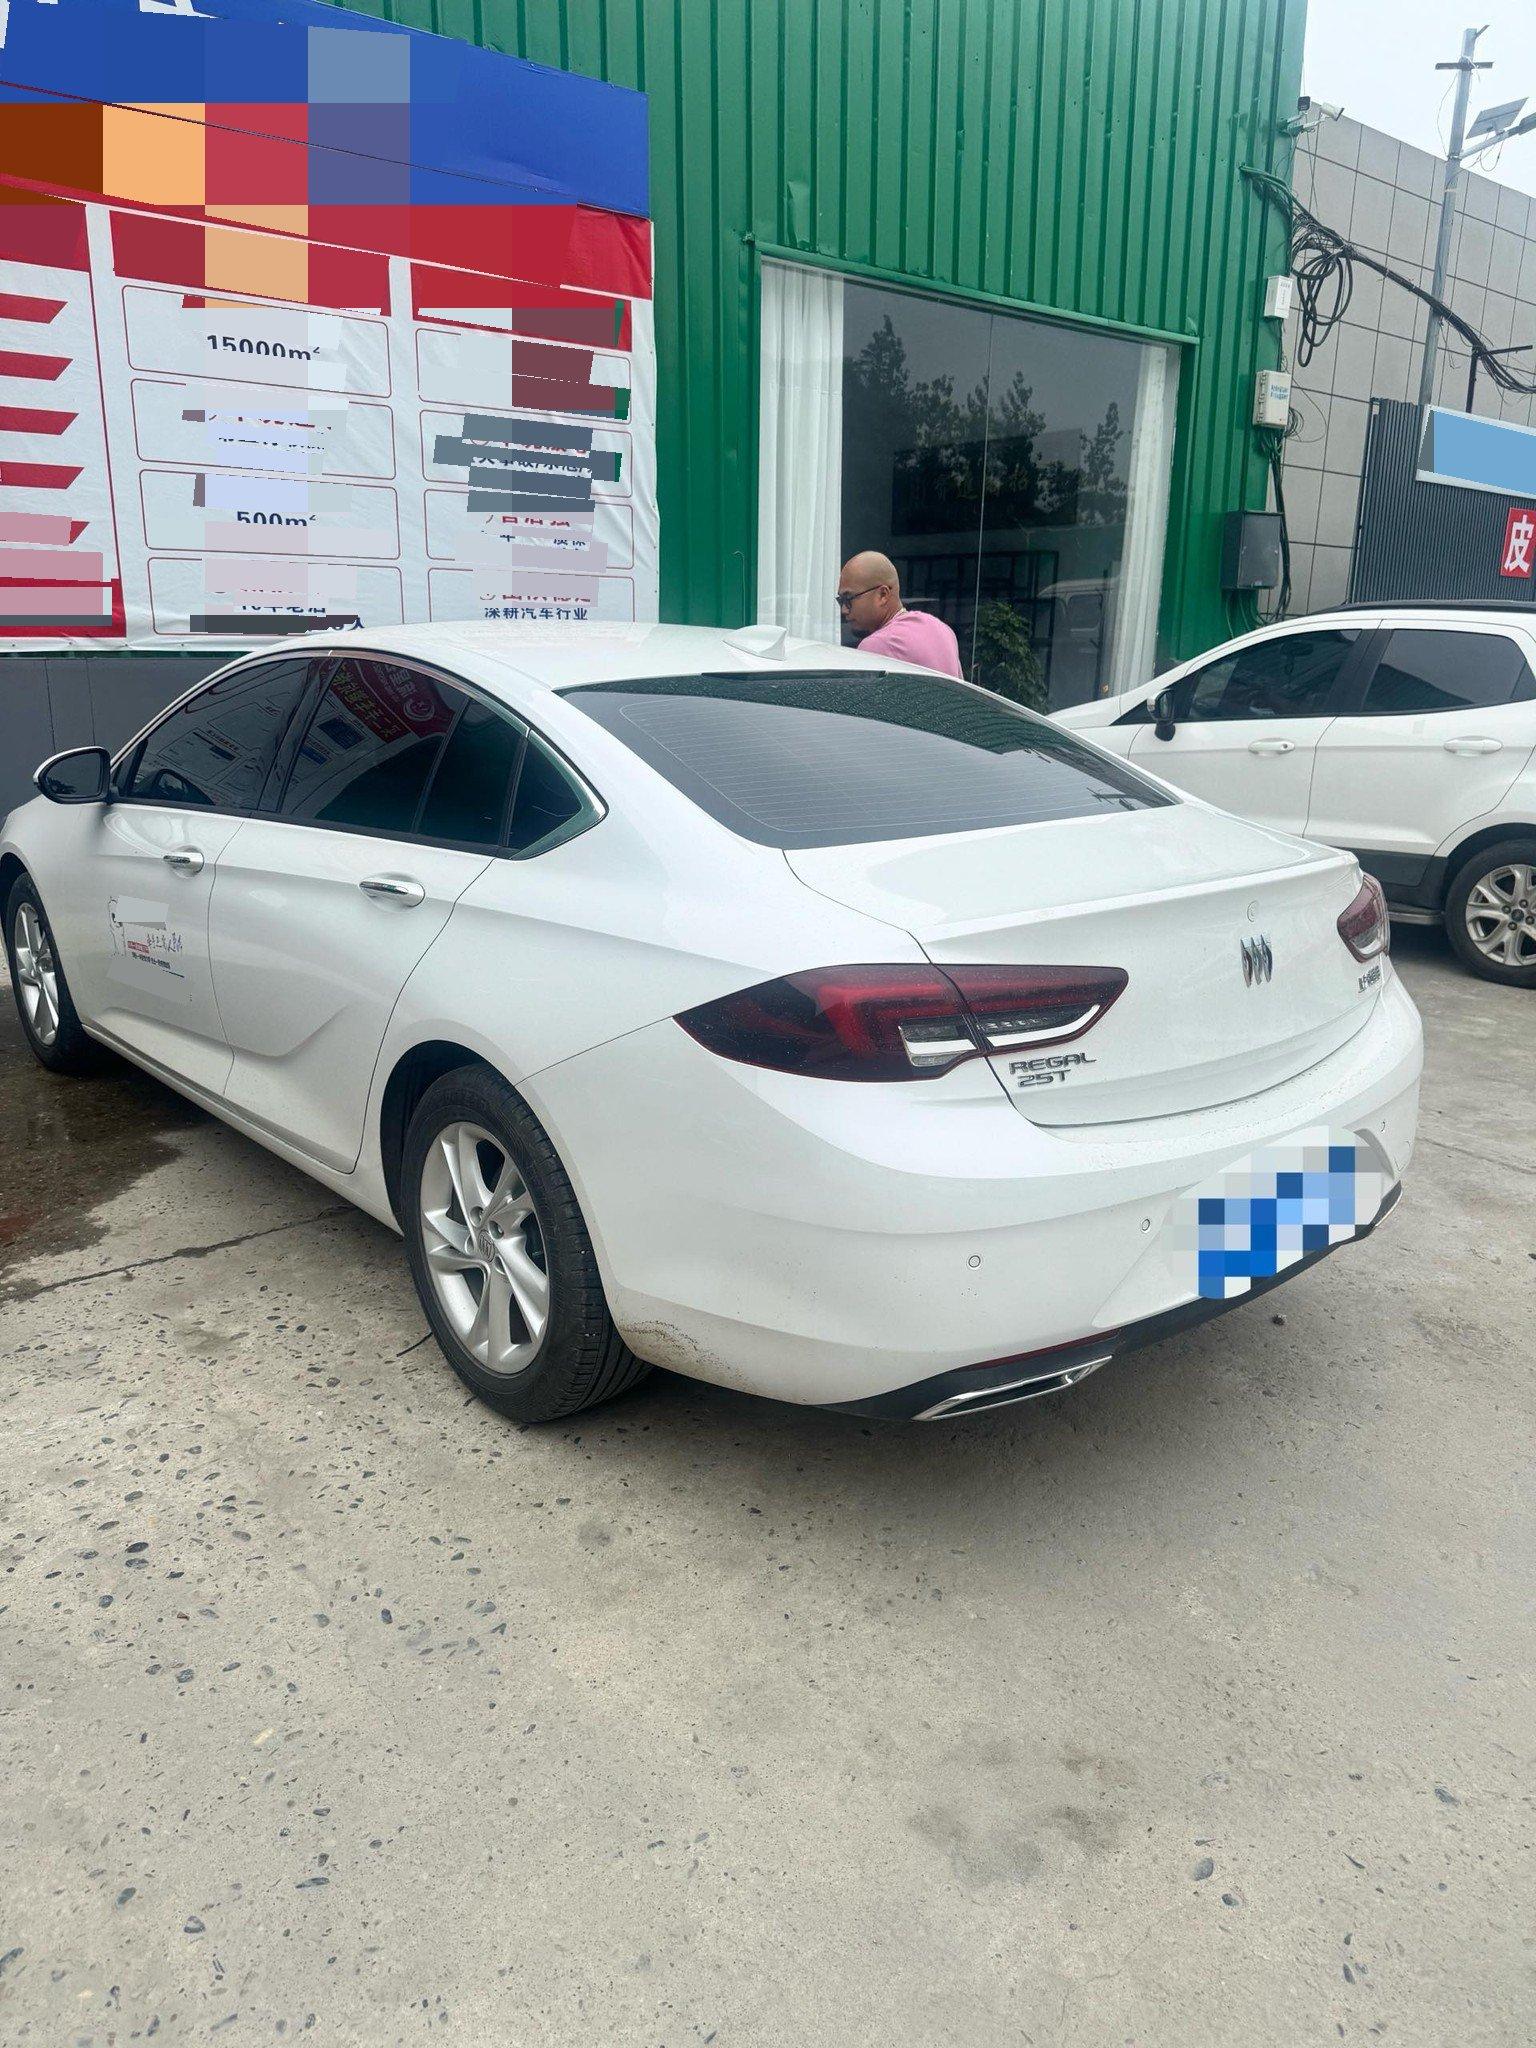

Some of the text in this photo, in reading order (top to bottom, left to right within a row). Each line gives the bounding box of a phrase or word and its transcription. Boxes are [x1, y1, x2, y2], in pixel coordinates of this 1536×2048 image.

[1504, 514, 1535, 573] 皮
[484, 607, 588, 621] 深耕汽车行业
[1009, 1053, 1097, 1075] REGAL
[1018, 1069, 1071, 1088] 25T
